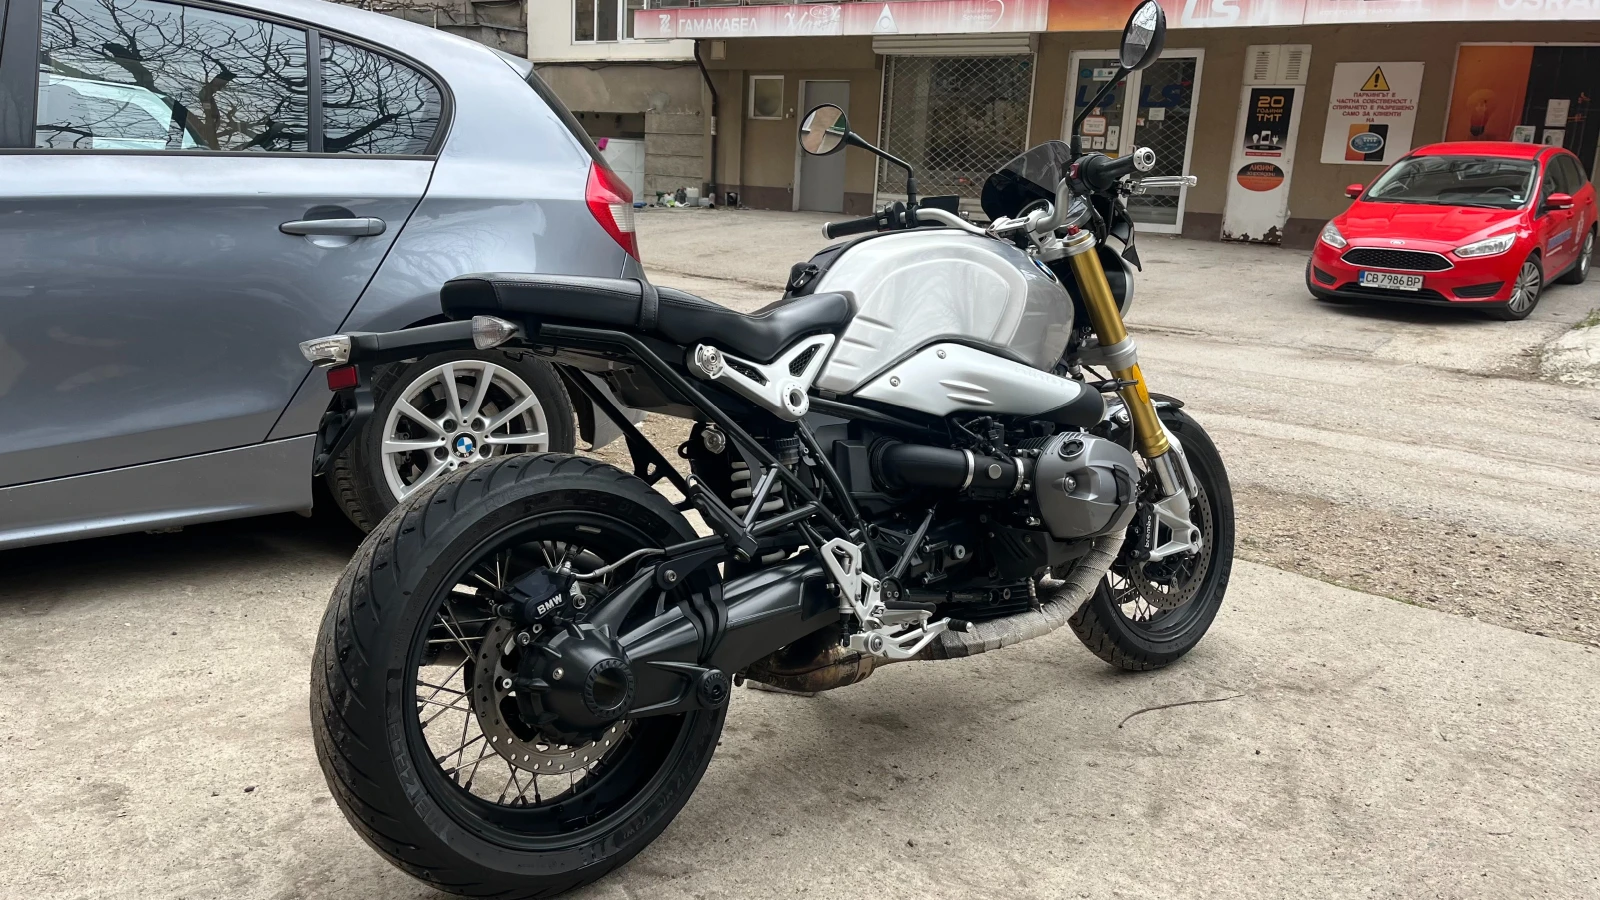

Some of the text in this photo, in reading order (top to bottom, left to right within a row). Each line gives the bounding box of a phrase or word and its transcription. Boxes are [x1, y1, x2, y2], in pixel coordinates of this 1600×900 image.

[679, 18, 758, 32] ГАМАКАБЕЛ
[1258, 96, 1284, 107] 20
[1366, 273, 1420, 286] CB 7986 BP
[537, 594, 562, 614] BMW
